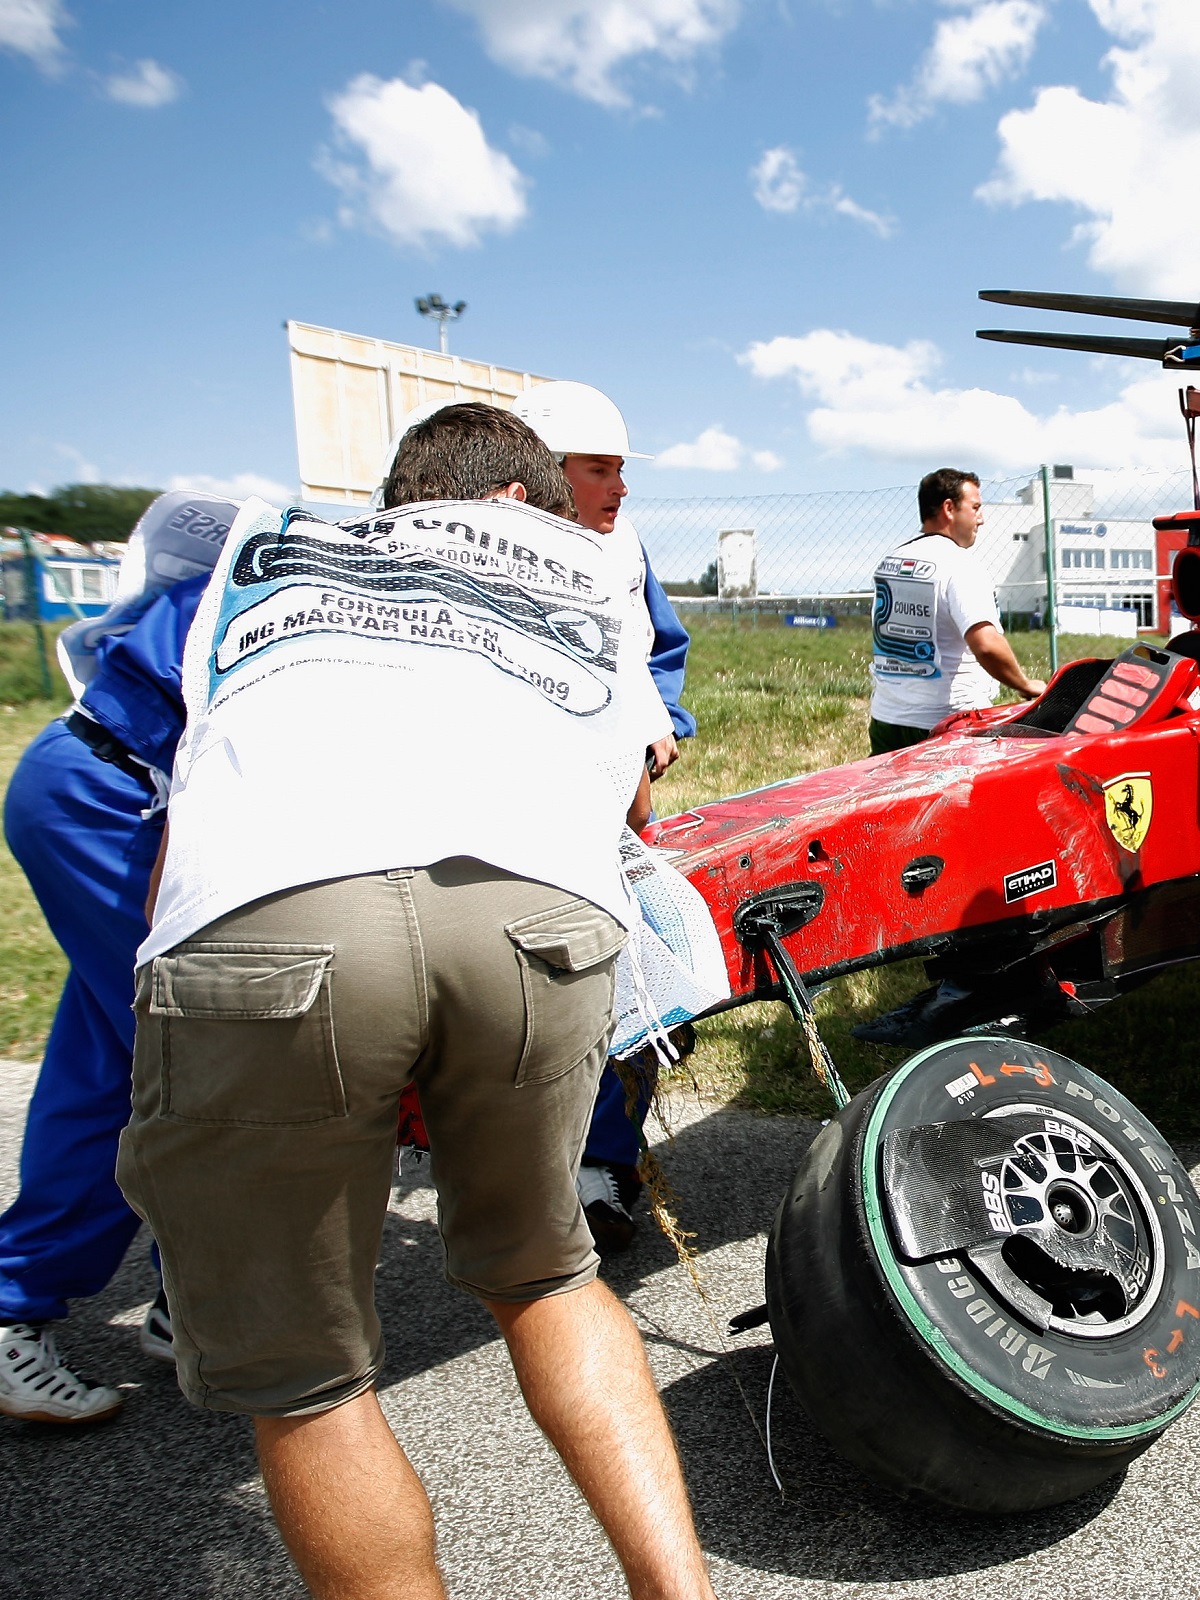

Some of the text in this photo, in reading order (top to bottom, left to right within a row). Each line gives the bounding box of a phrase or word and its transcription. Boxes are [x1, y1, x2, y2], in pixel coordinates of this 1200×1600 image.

[320, 593, 453, 627] FORMULA
[893, 600, 931, 618] COURSE
[238, 621, 275, 654] ING
[283, 608, 400, 634] MAGYAR
[1008, 867, 1052, 890] ETIHAD
[968, 1062, 997, 1087] L
[1044, 1119, 1093, 1150] BBS
[981, 1171, 1012, 1234] BBS
